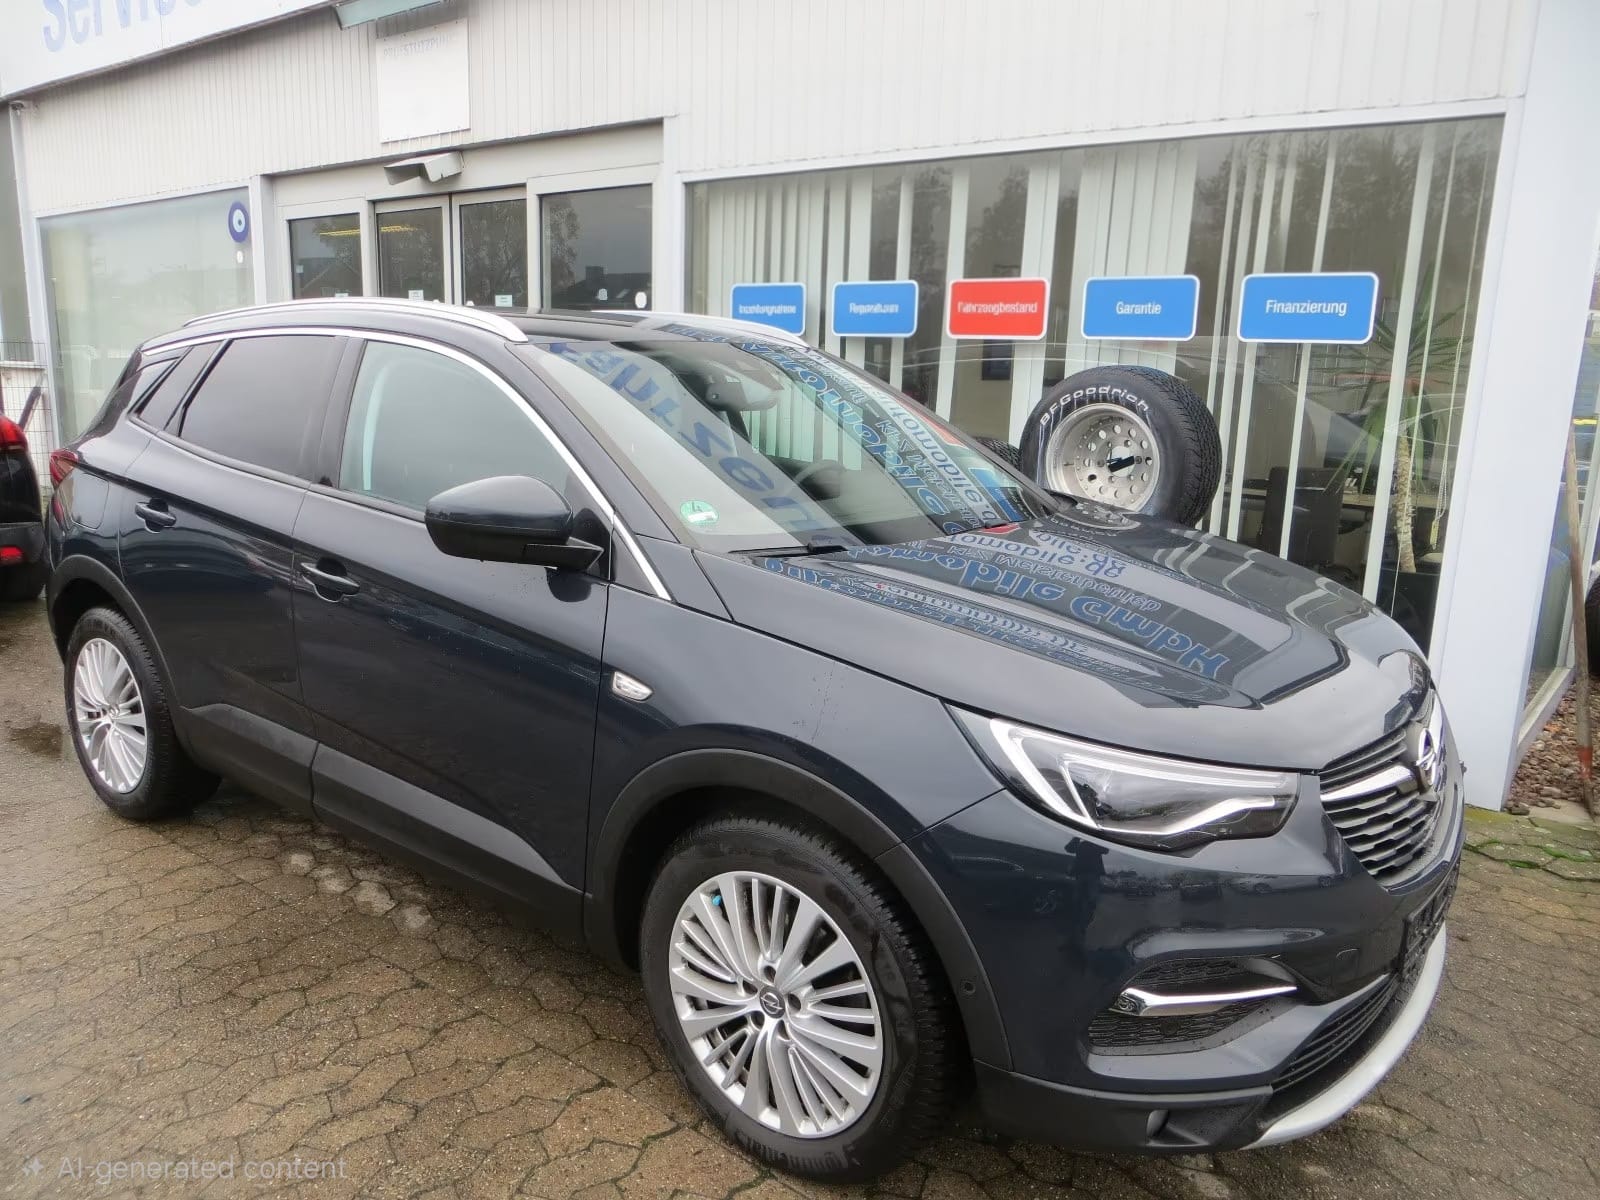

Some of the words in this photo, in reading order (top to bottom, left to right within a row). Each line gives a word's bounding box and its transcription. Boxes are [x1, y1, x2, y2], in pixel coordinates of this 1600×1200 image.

[43, 0, 205, 52] Serv
[1116, 301, 1162, 315] Garantie
[1265, 299, 1348, 317] Finanzierung
[1040, 385, 1149, 425] BFGoodrich
